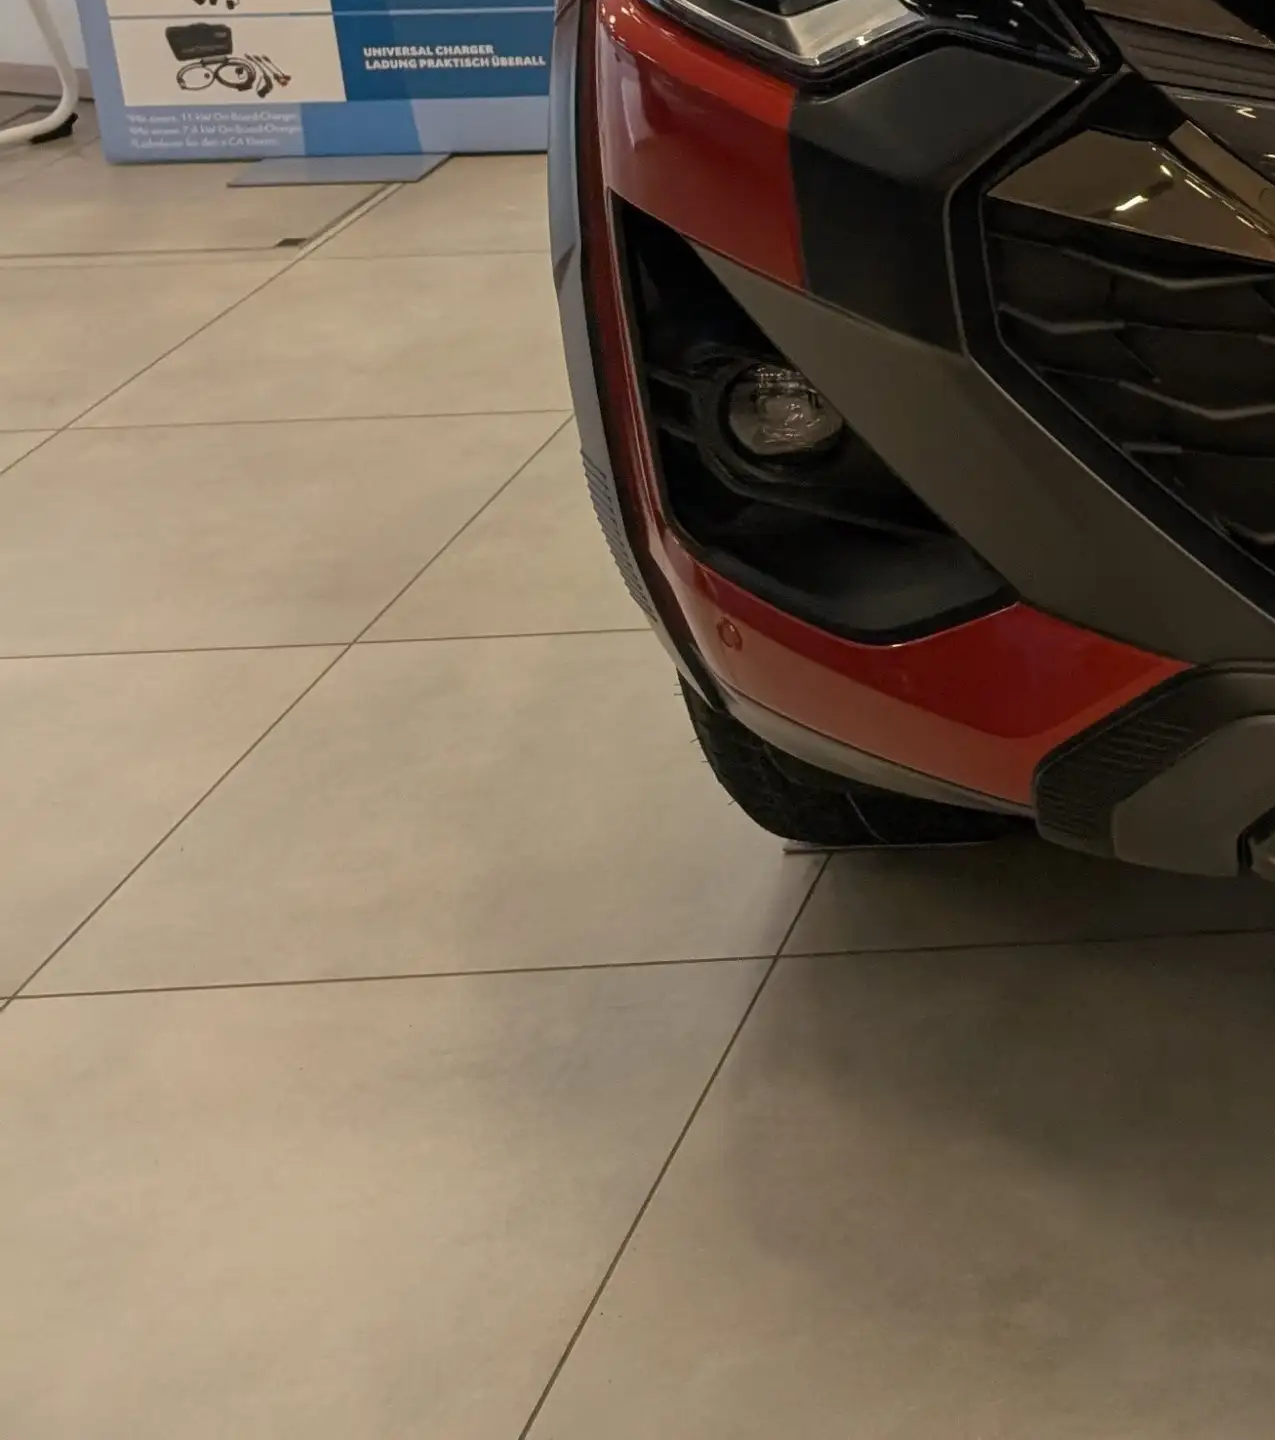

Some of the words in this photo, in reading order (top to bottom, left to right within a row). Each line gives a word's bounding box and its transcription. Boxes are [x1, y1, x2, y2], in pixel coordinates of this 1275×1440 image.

[363, 46, 433, 57] UNIVERSAL
[435, 44, 494, 55] CHARGER
[365, 59, 417, 70] LADUNG
[419, 57, 490, 69] PRAKTISCH
[491, 54, 546, 67] ÜBERALL
